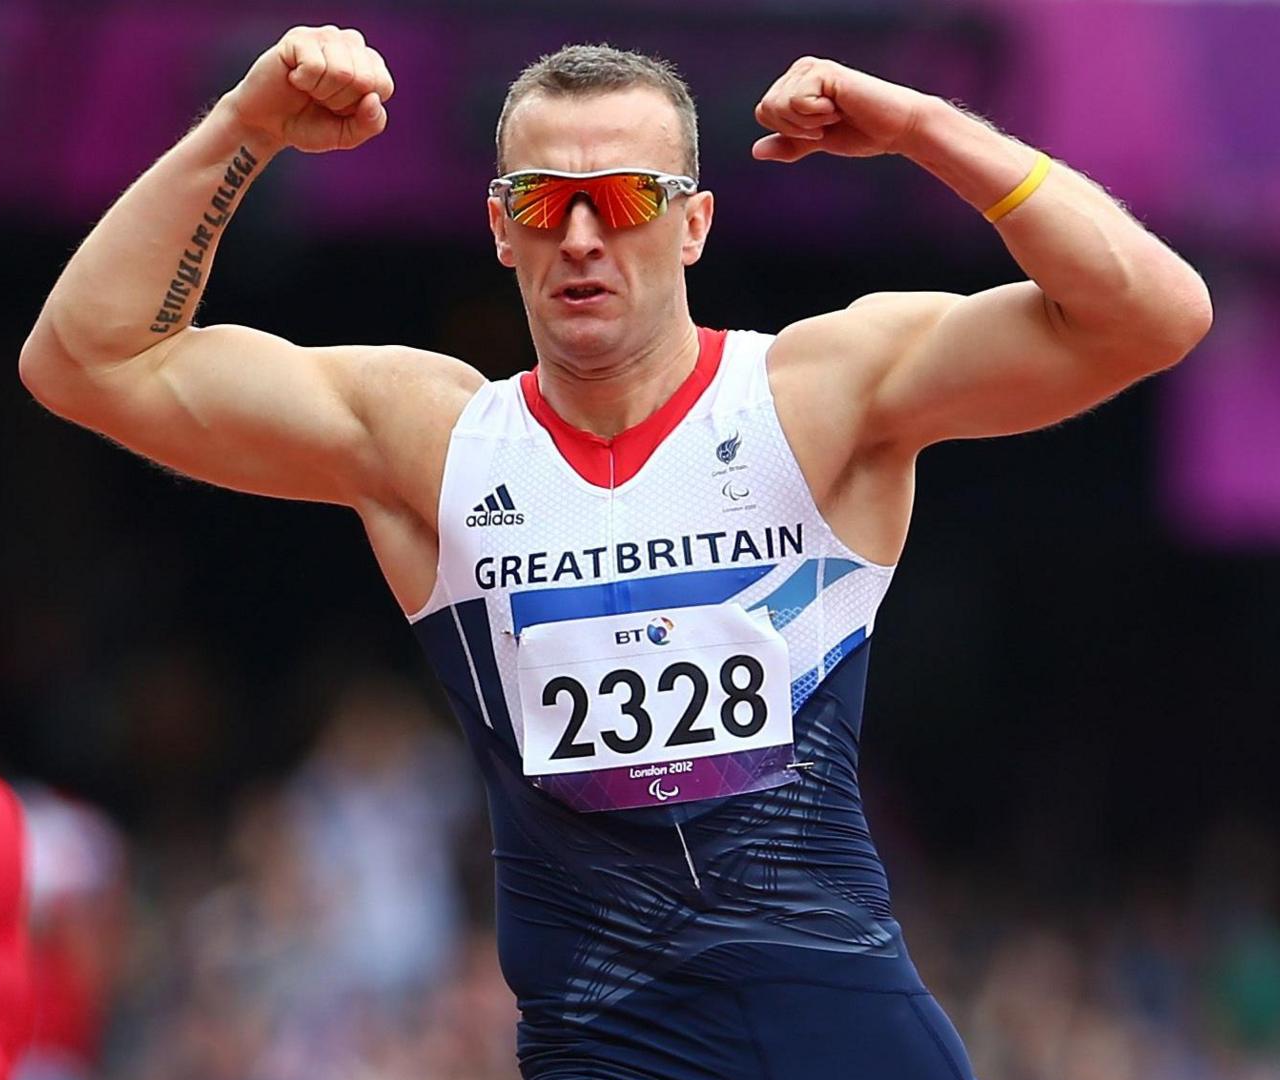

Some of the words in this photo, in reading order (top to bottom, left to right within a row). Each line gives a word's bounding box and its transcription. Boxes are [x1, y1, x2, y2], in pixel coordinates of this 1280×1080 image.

[465, 510, 525, 528] adidas
[474, 546, 608, 590] GREAT
[616, 523, 803, 575] BRITAIN
[615, 628, 644, 645] BT
[542, 654, 768, 761] 2328
[629, 764, 668, 779] London
[669, 761, 693, 774] 2012
